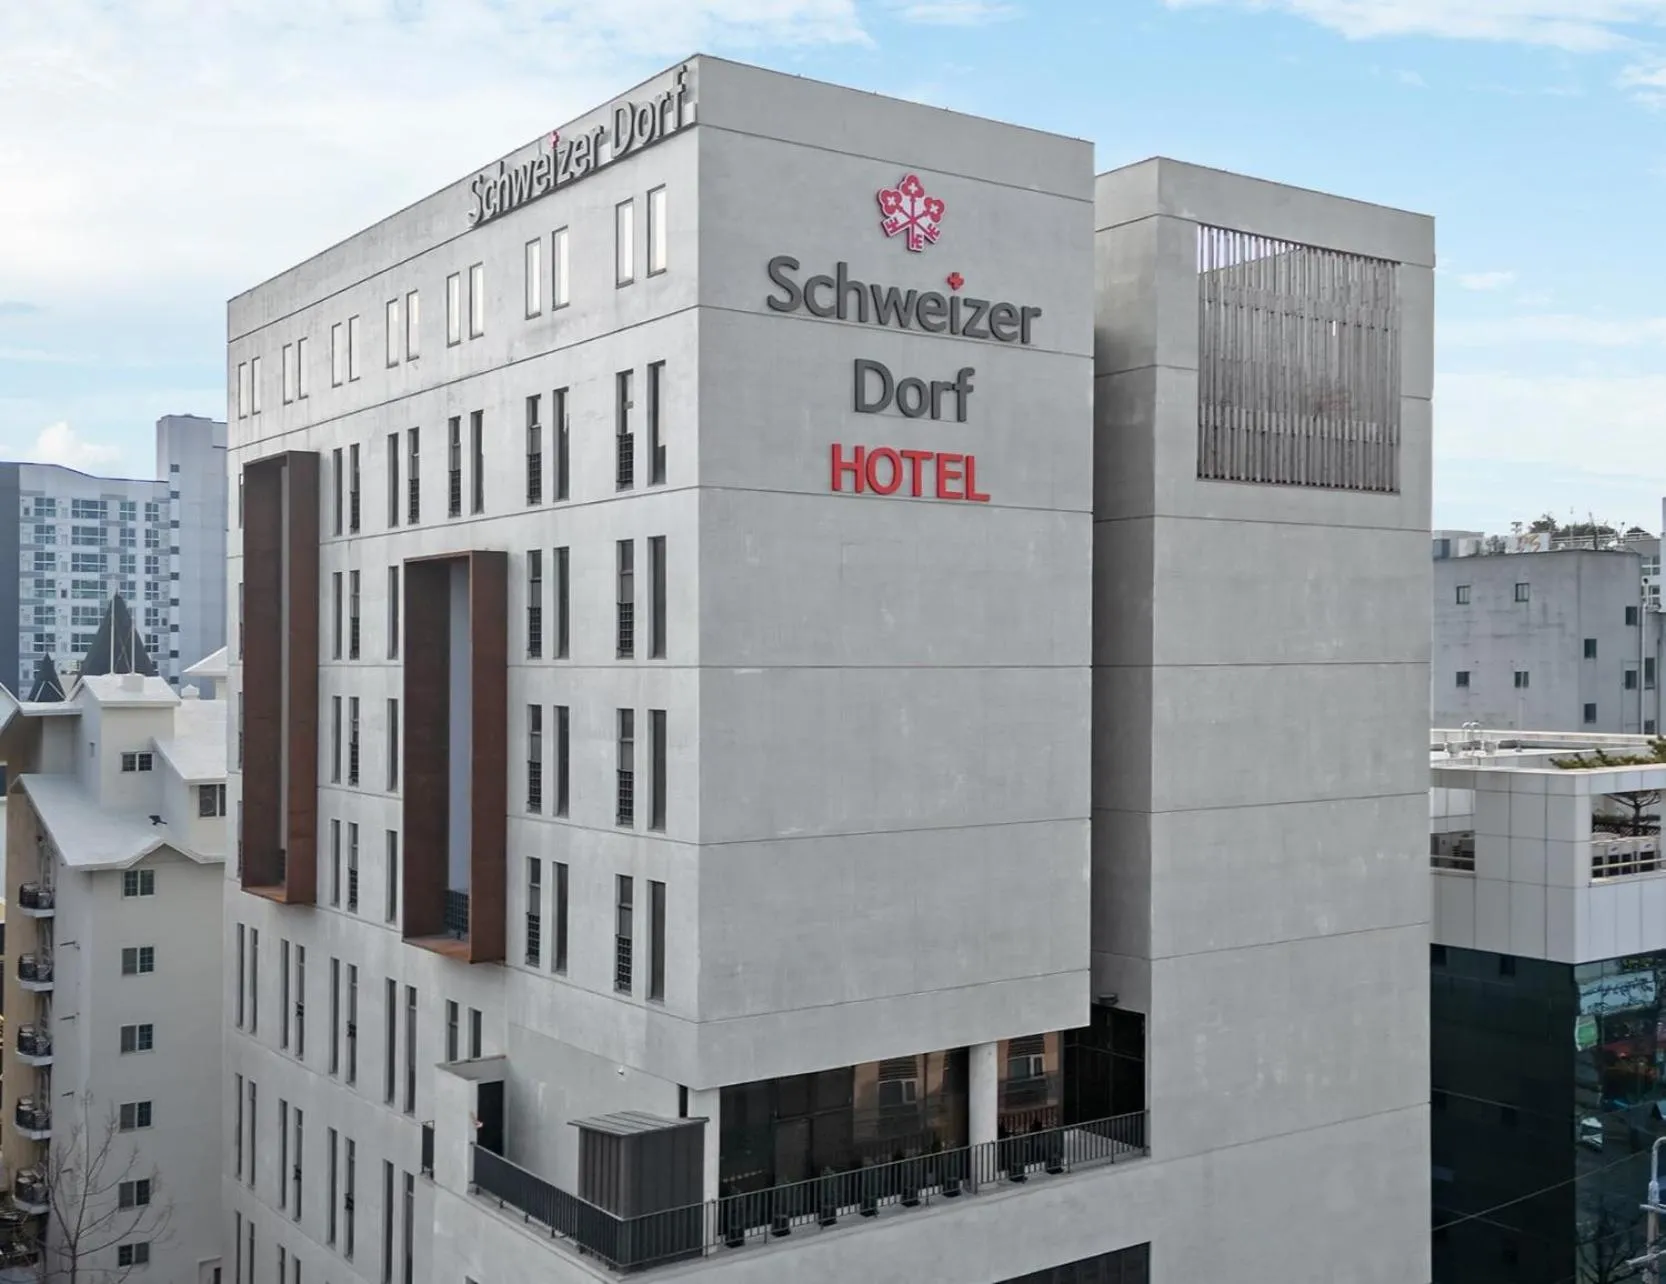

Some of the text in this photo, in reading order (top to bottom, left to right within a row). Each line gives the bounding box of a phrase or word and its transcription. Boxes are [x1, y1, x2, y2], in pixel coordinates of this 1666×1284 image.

[468, 64, 688, 227] Schweizer Dorf
[766, 255, 1042, 344] Schweizer
[854, 358, 976, 422] Dorf
[831, 443, 991, 502] HOTEL
